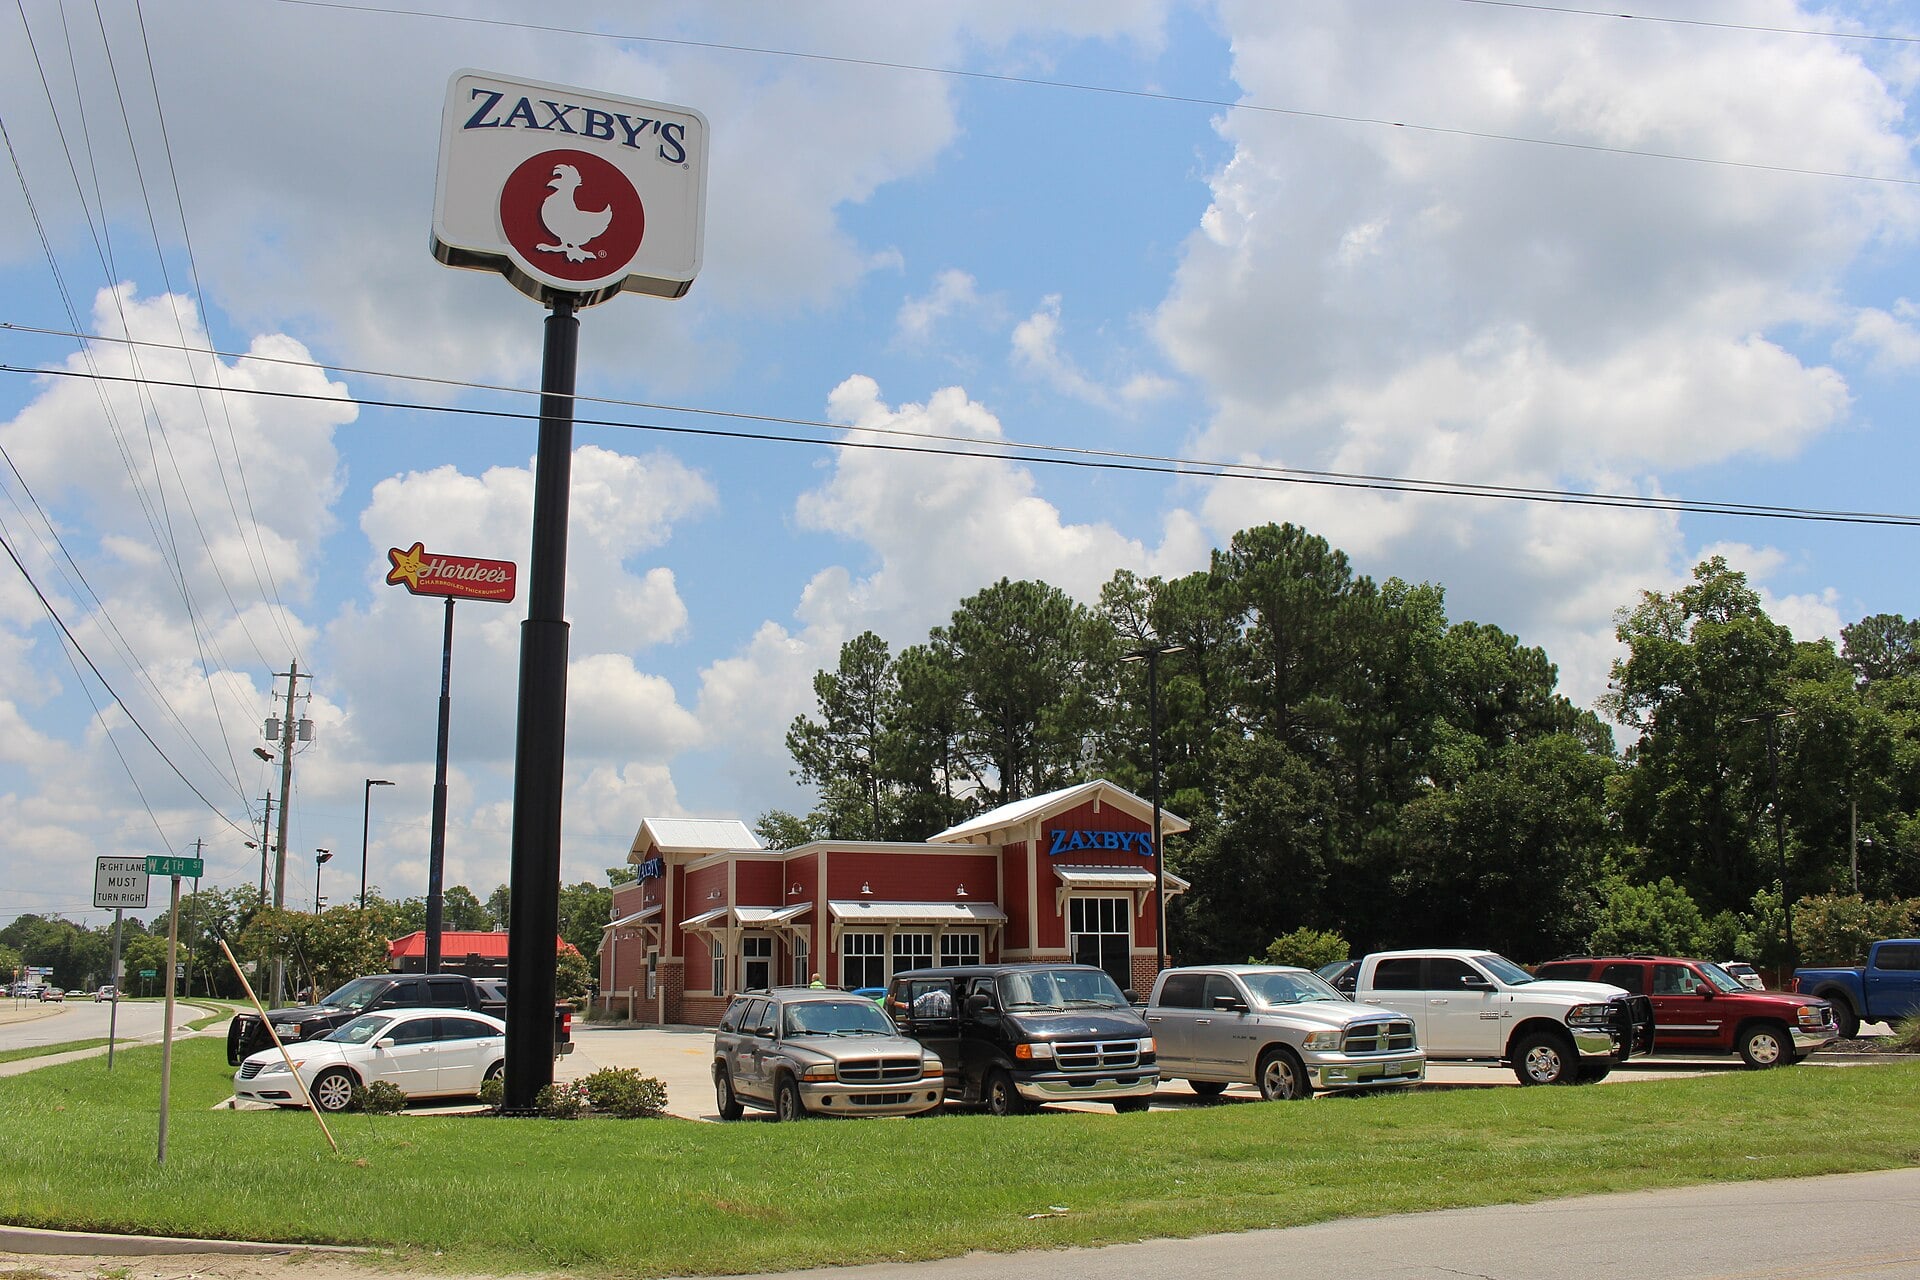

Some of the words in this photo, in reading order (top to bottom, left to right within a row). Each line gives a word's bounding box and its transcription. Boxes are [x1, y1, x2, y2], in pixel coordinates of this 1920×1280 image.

[463, 88, 687, 164] ZAXBY'S
[416, 559, 512, 583] Hardee's
[419, 579, 465, 590] CHARBROILED
[465, 586, 506, 596] THICKBURGERS
[1049, 829, 1153, 856] ZAXBY'S
[100, 862, 123, 871] RGHT
[126, 863, 146, 872] LANE
[162, 859, 184, 873] 4TH
[108, 877, 137, 887] MUST
[97, 892, 118, 901] TURN
[121, 893, 145, 902] RIGHT
